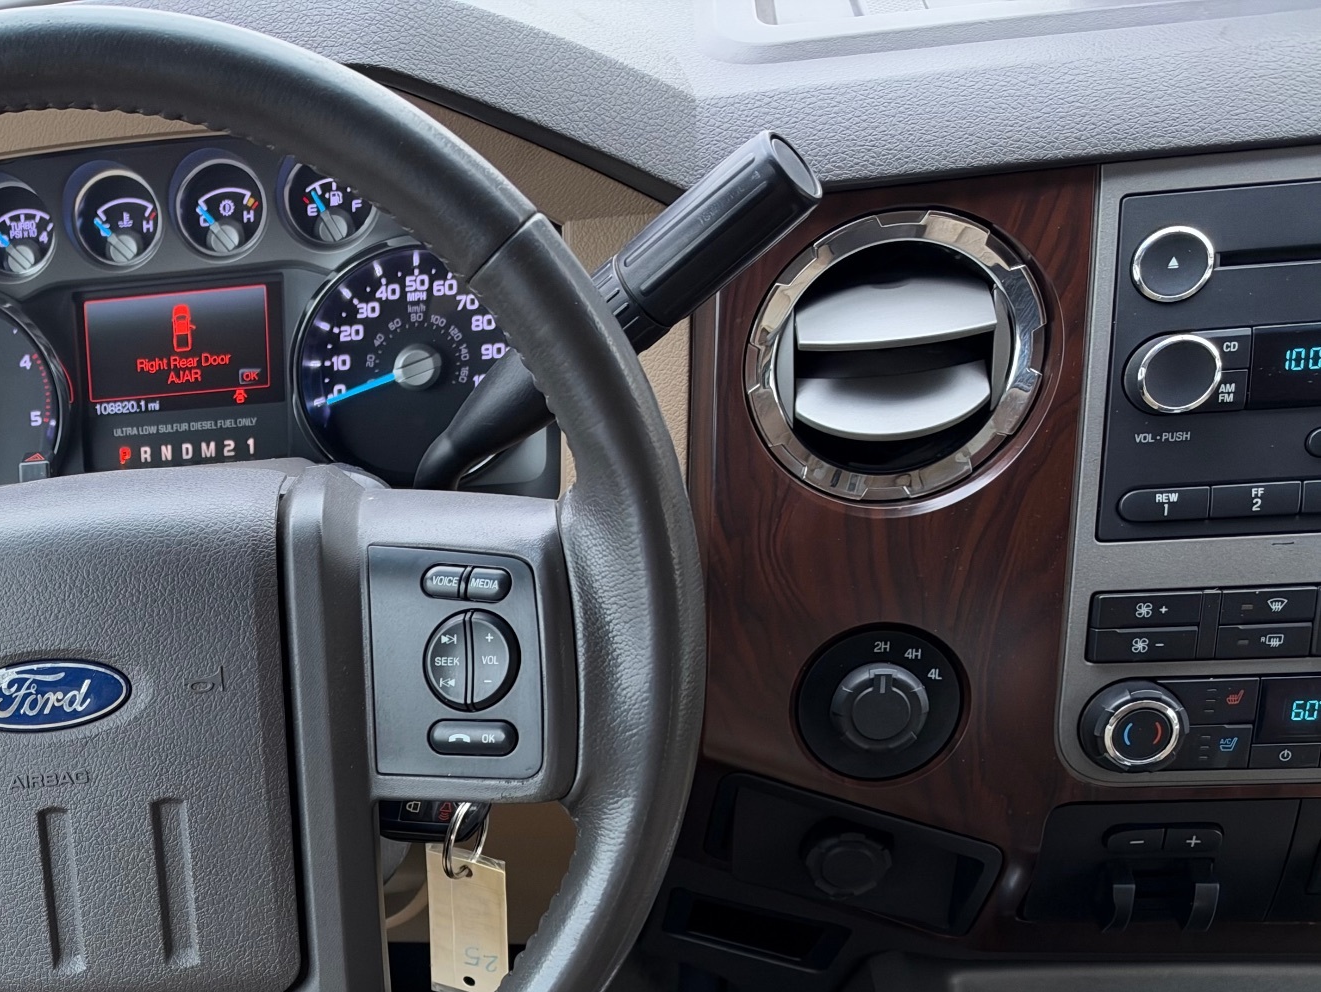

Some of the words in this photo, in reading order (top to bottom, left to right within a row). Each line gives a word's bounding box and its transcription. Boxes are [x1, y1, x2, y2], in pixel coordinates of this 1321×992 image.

[307, 204, 318, 216] E
[352, 200, 362, 212] F
[243, 210, 254, 223] H
[10, 220, 36, 231] TURBO
[143, 219, 153, 233] H
[10, 229, 22, 239] PSI
[29, 228, 37, 237] 10
[39, 231, 48, 244] 4
[406, 275, 428, 291] 50
[433, 280, 457, 296] 60
[376, 284, 400, 300] 40
[407, 292, 426, 302] MPH
[408, 304, 426, 313] km/h
[456, 294, 479, 311] 70
[357, 302, 380, 318] 30
[410, 313, 424, 322] 80
[430, 315, 446, 326] 100
[471, 315, 496, 331] 80
[340, 325, 364, 341] 20
[448, 325, 462, 341] 120
[459, 344, 469, 361] 140
[481, 343, 506, 360] 90
[1223, 341, 1238, 352] CD
[20, 355, 31, 370] 4
[137, 358, 168, 374] Right
[170, 356, 199, 368] Rear
[201, 353, 231, 366] Door
[332, 354, 350, 371] 10
[168, 370, 202, 384] AJAR
[243, 371, 259, 381] OK
[1219, 383, 1236, 393] AM
[1218, 393, 1234, 403] FM
[95, 400, 146, 415] 108820.1
[148, 400, 160, 411] mi
[30, 411, 41, 426] 5
[113, 427, 138, 437] ULTRA
[139, 425, 157, 435] LOW
[158, 423, 189, 433] SULFUR
[190, 421, 217, 431] DIESEL
[218, 419, 237, 429] FUEL
[237, 417, 257, 427] ONLY
[1135, 433, 1154, 443] VOL
[1161, 431, 1190, 442] PUSH
[119, 447, 131, 464] P
[140, 447, 151, 462] R
[161, 445, 172, 461] N
[182, 443, 193, 459] D
[201, 441, 216, 458] M
[223, 440, 235, 456] 2
[247, 438, 254, 454] 1
[1155, 493, 1178, 503] REW
[1251, 488, 1264, 498] FF
[1163, 504, 1168, 516] 1
[1252, 499, 1261, 511] 2
[432, 576, 459, 586] VOICE
[470, 578, 499, 589] MEDIA
[874, 641, 890, 652] 2H
[481, 655, 499, 665] VOL
[904, 649, 921, 660] 4H
[434, 657, 460, 666] SEEK
[928, 669, 942, 680] 4L
[481, 734, 495, 744] OK
[8, 770, 91, 790] AIRBAG
